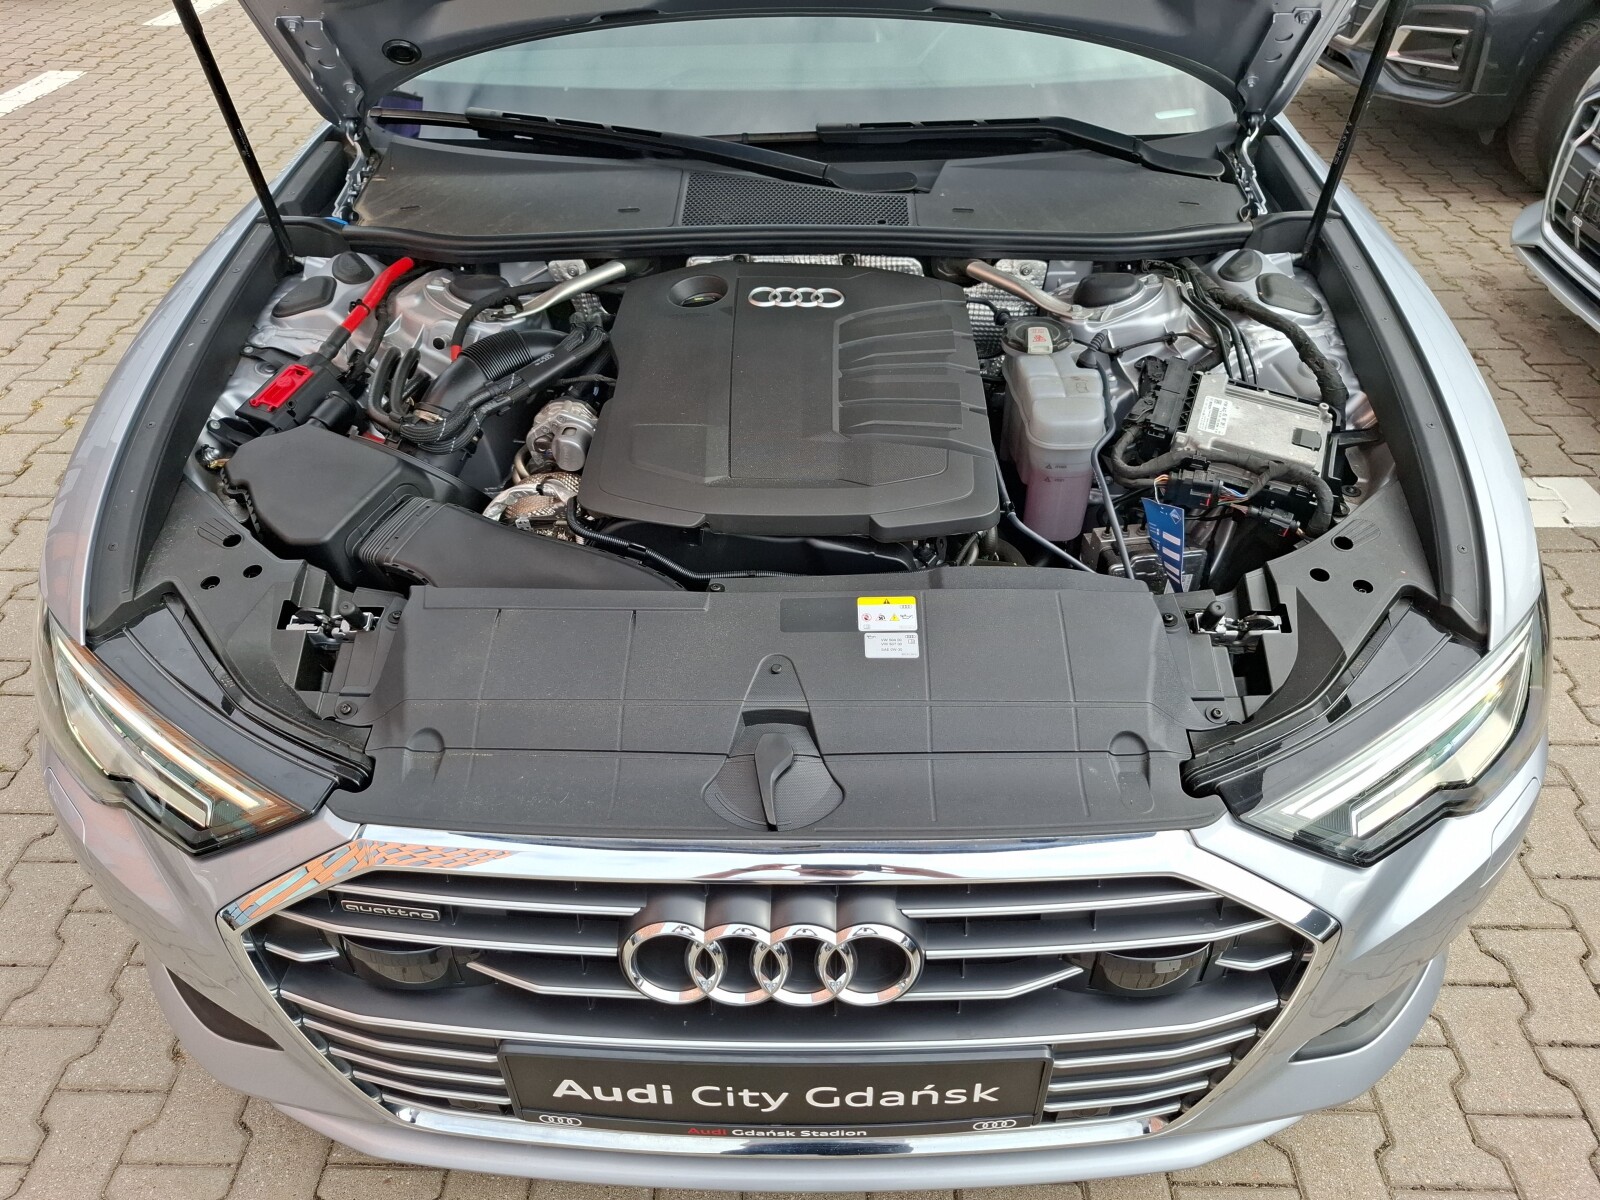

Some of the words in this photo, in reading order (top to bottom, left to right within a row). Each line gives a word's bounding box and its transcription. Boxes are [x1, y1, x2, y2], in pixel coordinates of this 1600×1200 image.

[345, 903, 435, 919] quattro
[552, 1078, 673, 1105] Audi
[691, 1083, 790, 1112] City
[805, 1082, 1000, 1107] Gdańsk
[687, 1127, 727, 1136] Audi
[731, 1128, 798, 1137] Gdańsk
[800, 1128, 867, 1137] Stadion
